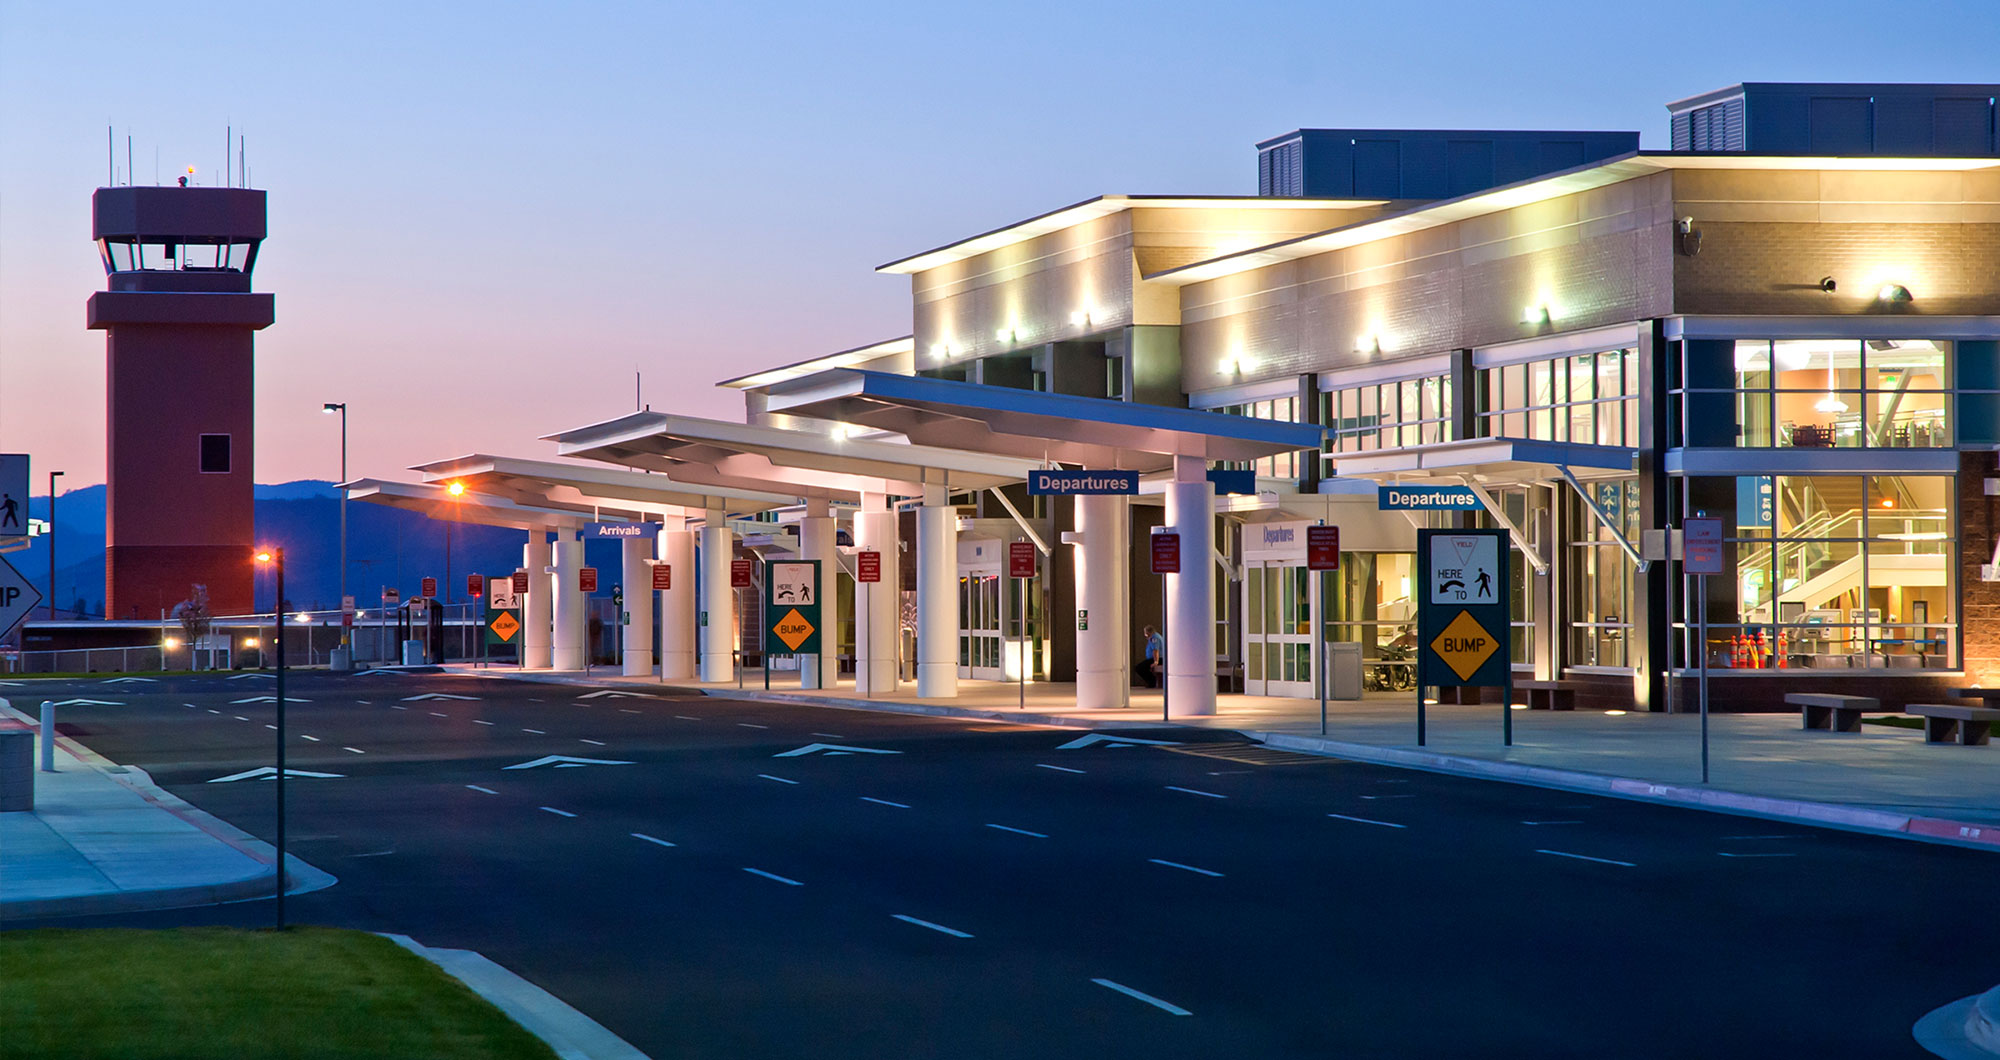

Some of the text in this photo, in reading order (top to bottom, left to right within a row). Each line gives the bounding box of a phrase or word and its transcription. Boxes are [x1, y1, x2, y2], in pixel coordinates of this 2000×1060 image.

[1039, 475, 1129, 493] Departures
[1388, 491, 1475, 508] Departures
[599, 525, 641, 535] Arrivals
[1263, 525, 1294, 547] Departures
[1438, 569, 1463, 579] HERE
[777, 583, 793, 591] HERE
[1455, 590, 1467, 600] TO
[780, 624, 807, 634] BUMP
[1443, 638, 1486, 652] BUMP
